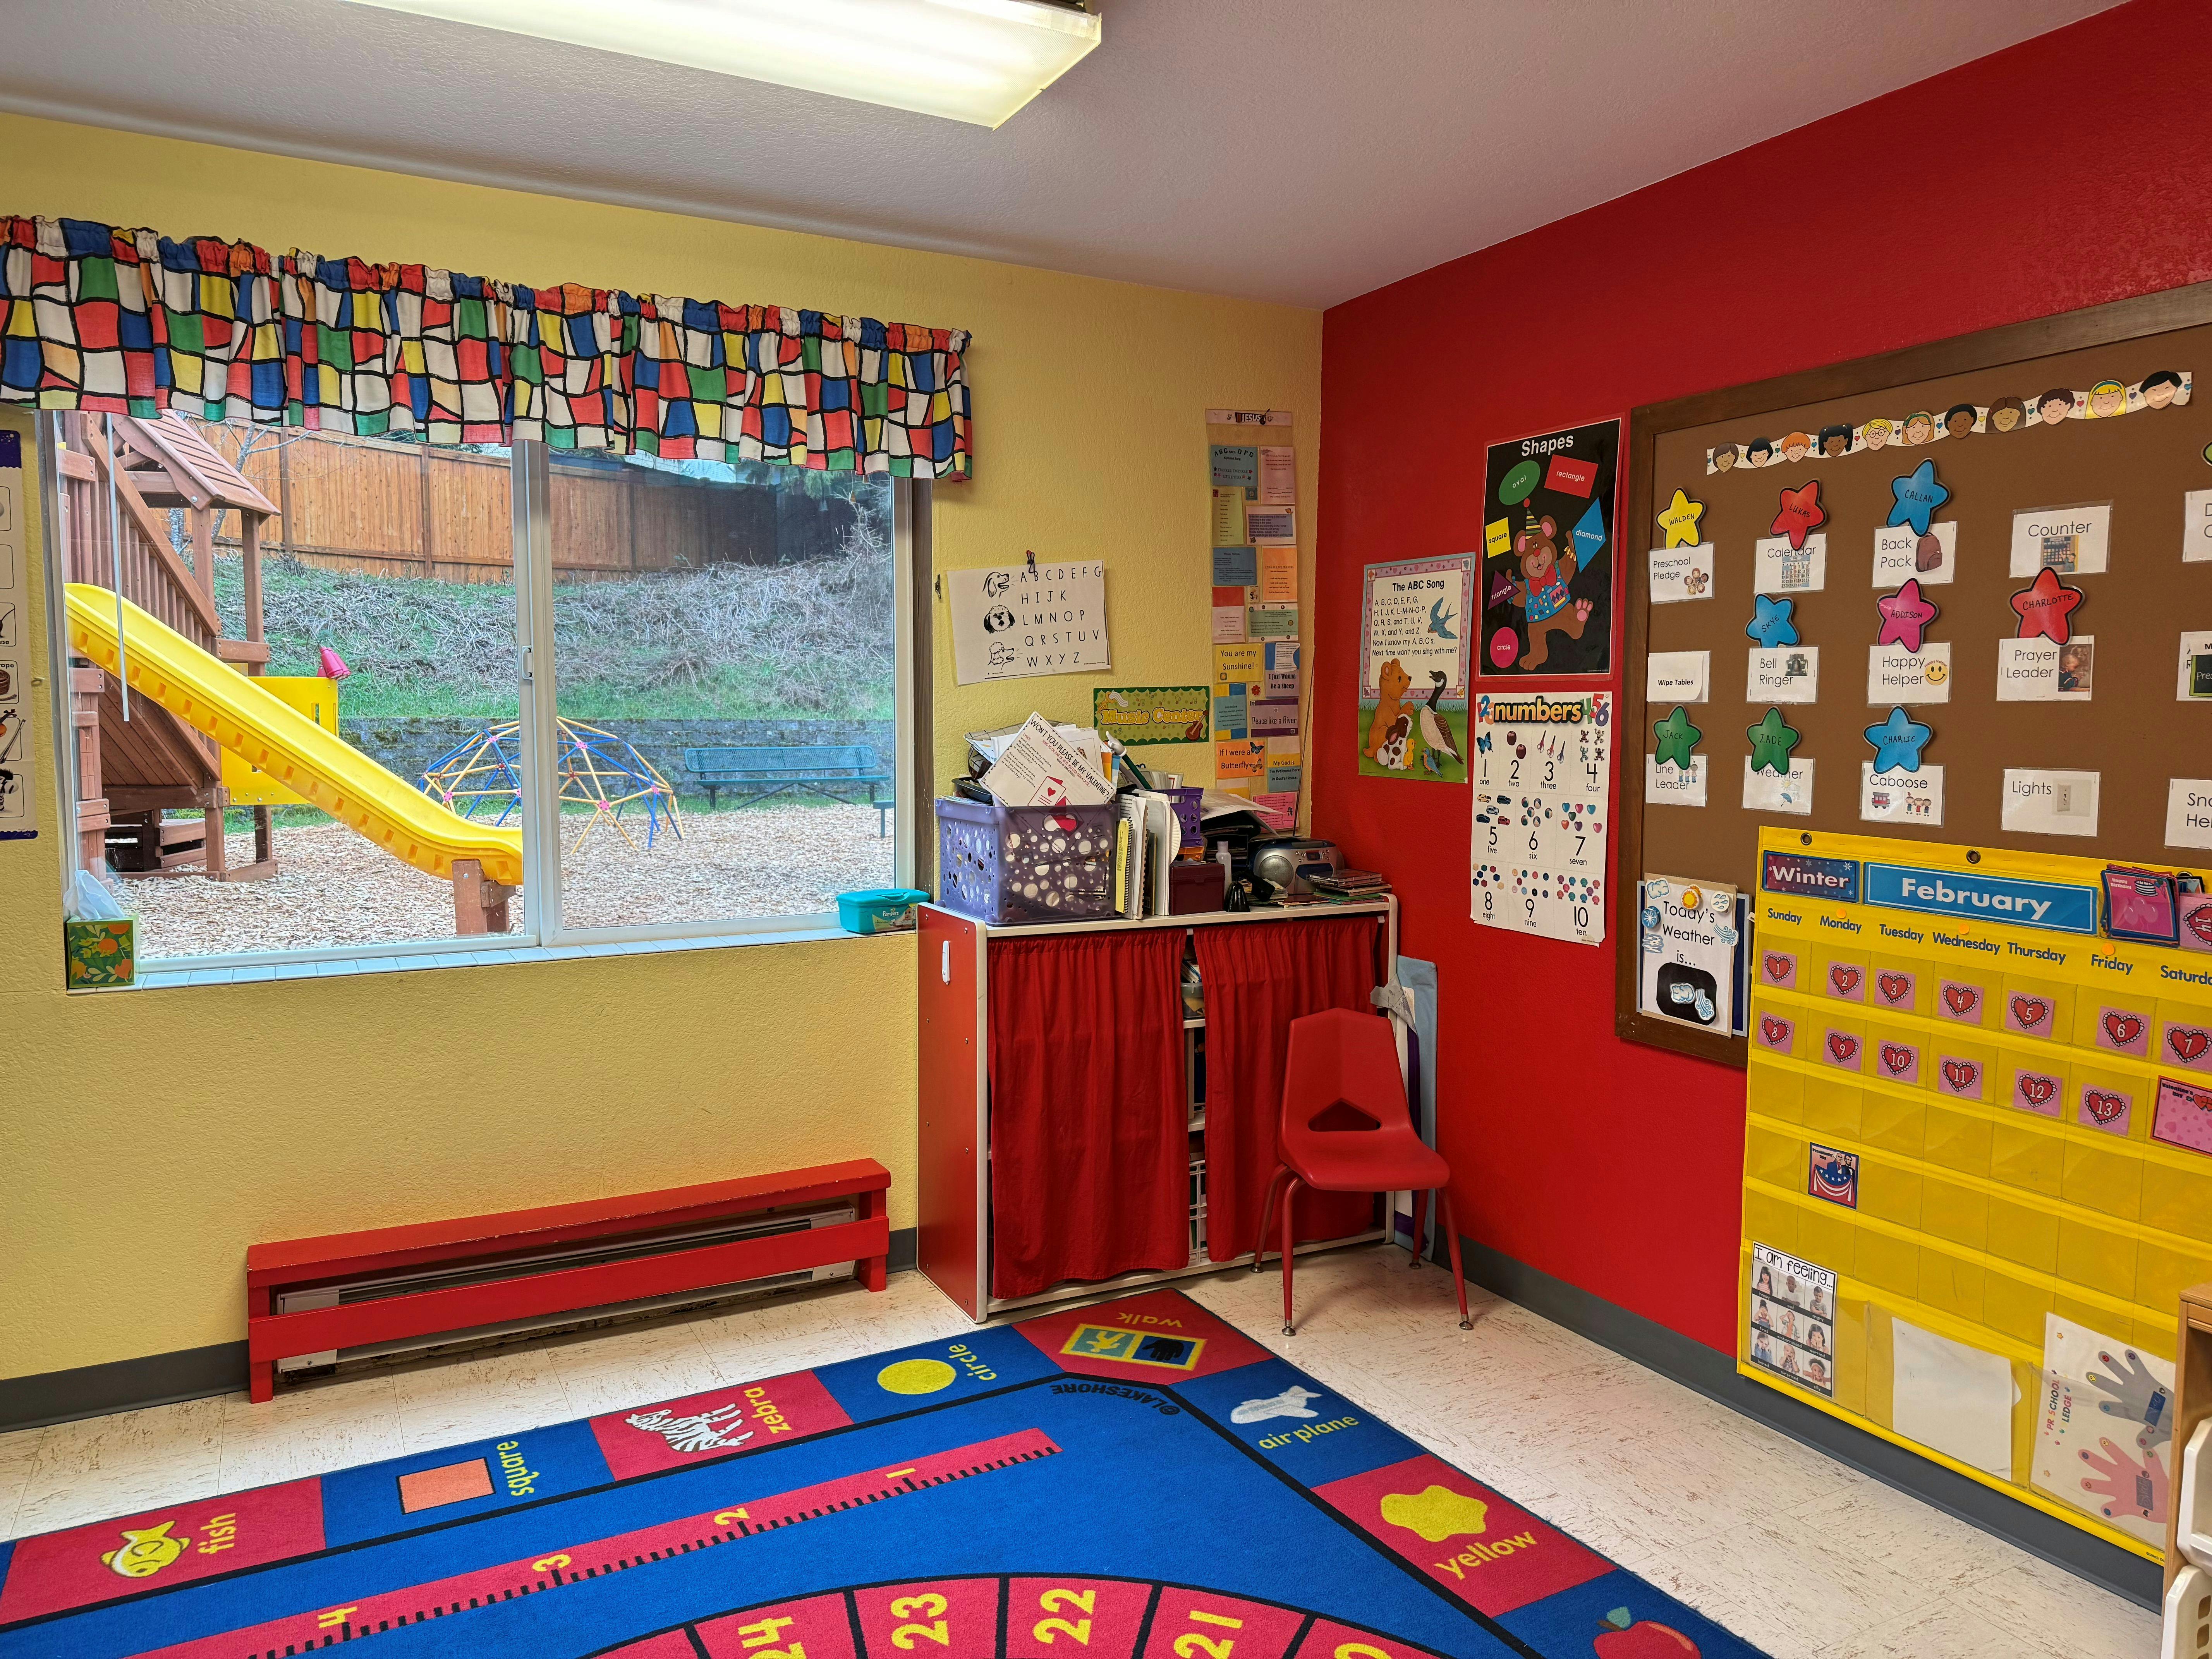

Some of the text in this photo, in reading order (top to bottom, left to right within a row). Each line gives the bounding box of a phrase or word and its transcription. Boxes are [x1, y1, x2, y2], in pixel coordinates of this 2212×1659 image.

[1521, 434, 1574, 457] Shapes
[1512, 474, 1527, 488] oval
[1556, 471, 1585, 482] rectangle
[1904, 489, 1934, 503] CALLAN
[1789, 503, 1811, 518] LUKAS
[1669, 513, 1695, 526] WALDEN
[1575, 529, 1603, 541] diamond
[2028, 521, 2092, 537] Counter
[1489, 532, 1507, 544] square
[1881, 537, 1912, 550] Back
[1767, 546, 1816, 558] Calendar
[1653, 557, 1691, 568] Preschool
[1881, 555, 1912, 568] Pack
[1653, 570, 1680, 582] Pledge
[1392, 579, 1444, 592] The ABC Song
[1491, 584, 1511, 601] triangle
[2022, 593, 2074, 611] CHARLOTTE
[1891, 610, 1923, 619] ADDISON
[1761, 614, 1780, 633] SKYE
[1496, 643, 1511, 651] circle
[1760, 658, 1777, 669] Bell
[1882, 656, 1926, 669] Happy
[2014, 649, 2057, 663] Prayer
[1882, 673, 1924, 687] Helper
[2006, 666, 2054, 679] Leader
[1759, 675, 1794, 687] Ringer
[1101, 708, 1150, 725] Music
[1152, 707, 1203, 724] Center
[1494, 696, 1582, 723] numbers
[1663, 730, 1683, 740] JACK
[1759, 734, 1782, 746] ZADE
[1883, 735, 1916, 745] CHARLIE
[1030, 718, 1109, 797] WON'T YOU PLEASE BE MY VALENTINE?
[1221, 761, 1249, 770] Butterfly
[1656, 764, 1673, 774] Line
[1757, 768, 1803, 779] Weaher
[1540, 781, 1557, 789] three
[1586, 783, 1601, 792] four
[1656, 778, 1690, 790] Leader
[1870, 774, 1928, 789] Caboose
[2012, 781, 2052, 796] Lights
[1487, 845, 1497, 854] five
[1772, 865, 1850, 888] Winter
[1902, 878, 2052, 921] February
[1663, 901, 1714, 923] Today's
[1482, 912, 1495, 921] eight
[1577, 927, 1587, 936] ten
[1662, 924, 1715, 946] Weather
[1767, 907, 1802, 925] Sunday
[1820, 915, 1862, 934] Monday
[1879, 923, 1924, 944] Tuesday
[1932, 931, 2000, 955] Wednesday
[2007, 942, 2066, 965] Thursday
[2091, 953, 2133, 975] Friday
[1676, 950, 1696, 966] is...
[1954, 1069, 2113, 1116] 11 12 13
[2162, 1082, 2194, 1095] Valentine's
[1755, 1247, 1834, 1289] I am feeling...
[1116, 1312, 1182, 1328] walk
[948, 1343, 997, 1381] circle
[744, 1386, 792, 1434] zebra
[2047, 1379, 2060, 1430] PRSCHOOL
[2061, 1395, 2072, 1426] LEDGE
[496, 1441, 540, 1496] square
[198, 1513, 236, 1554] fish
[318, 1467, 916, 1628] 4 3 2 1
[1434, 1531, 1537, 1580] yellow
[890, 1592, 949, 1650] 23
[1033, 1588, 1096, 1646] 22
